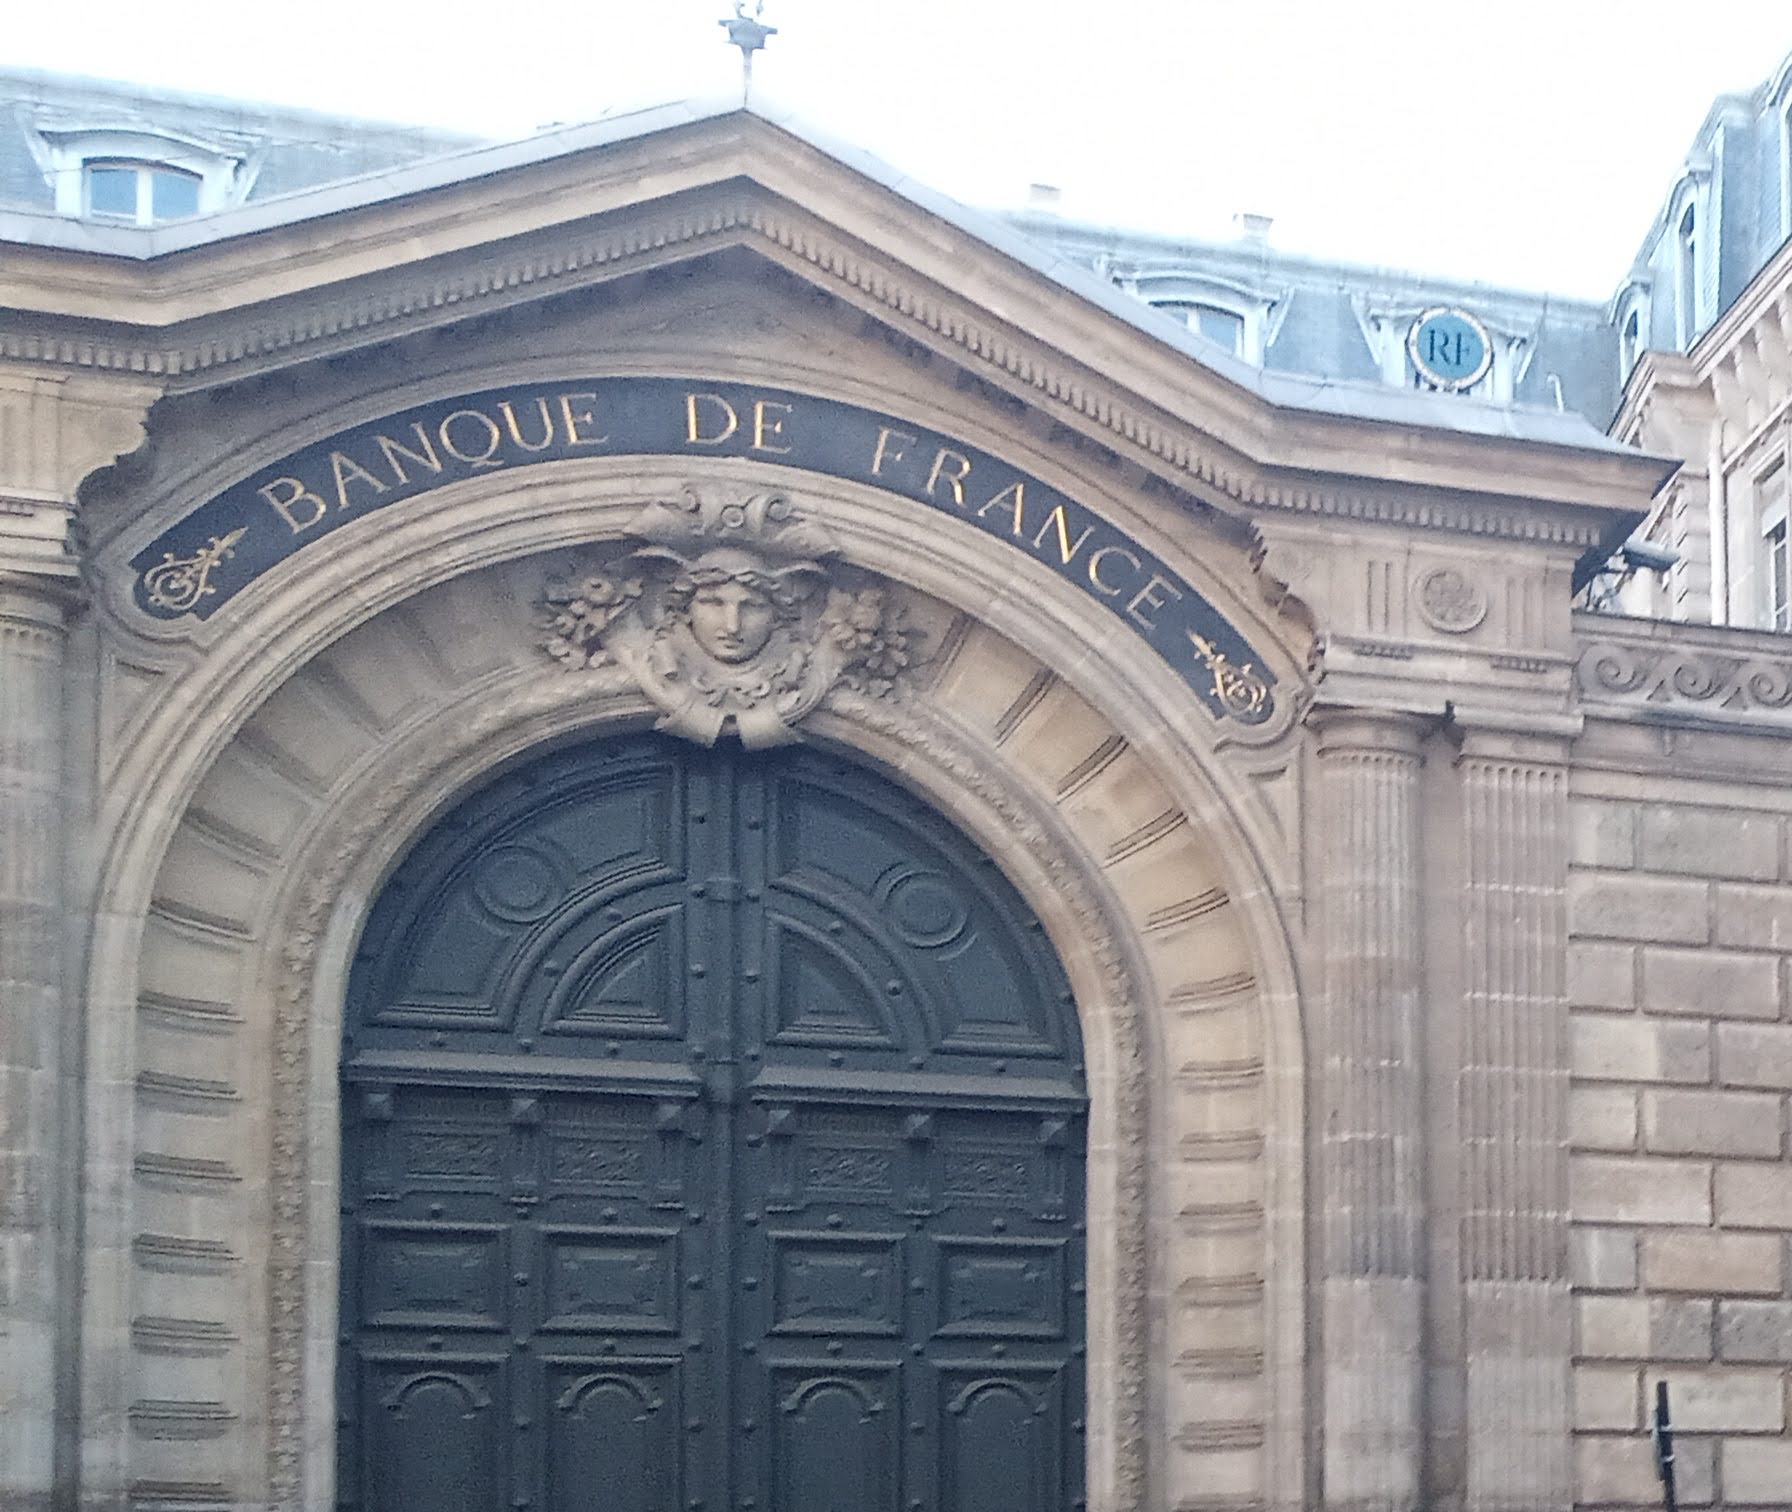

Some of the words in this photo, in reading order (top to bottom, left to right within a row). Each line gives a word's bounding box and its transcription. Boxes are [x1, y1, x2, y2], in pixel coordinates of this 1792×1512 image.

[1427, 328, 1475, 367] RF
[257, 388, 606, 538] BANQUE
[684, 390, 796, 456] DE
[870, 424, 1188, 632] FRANCE
